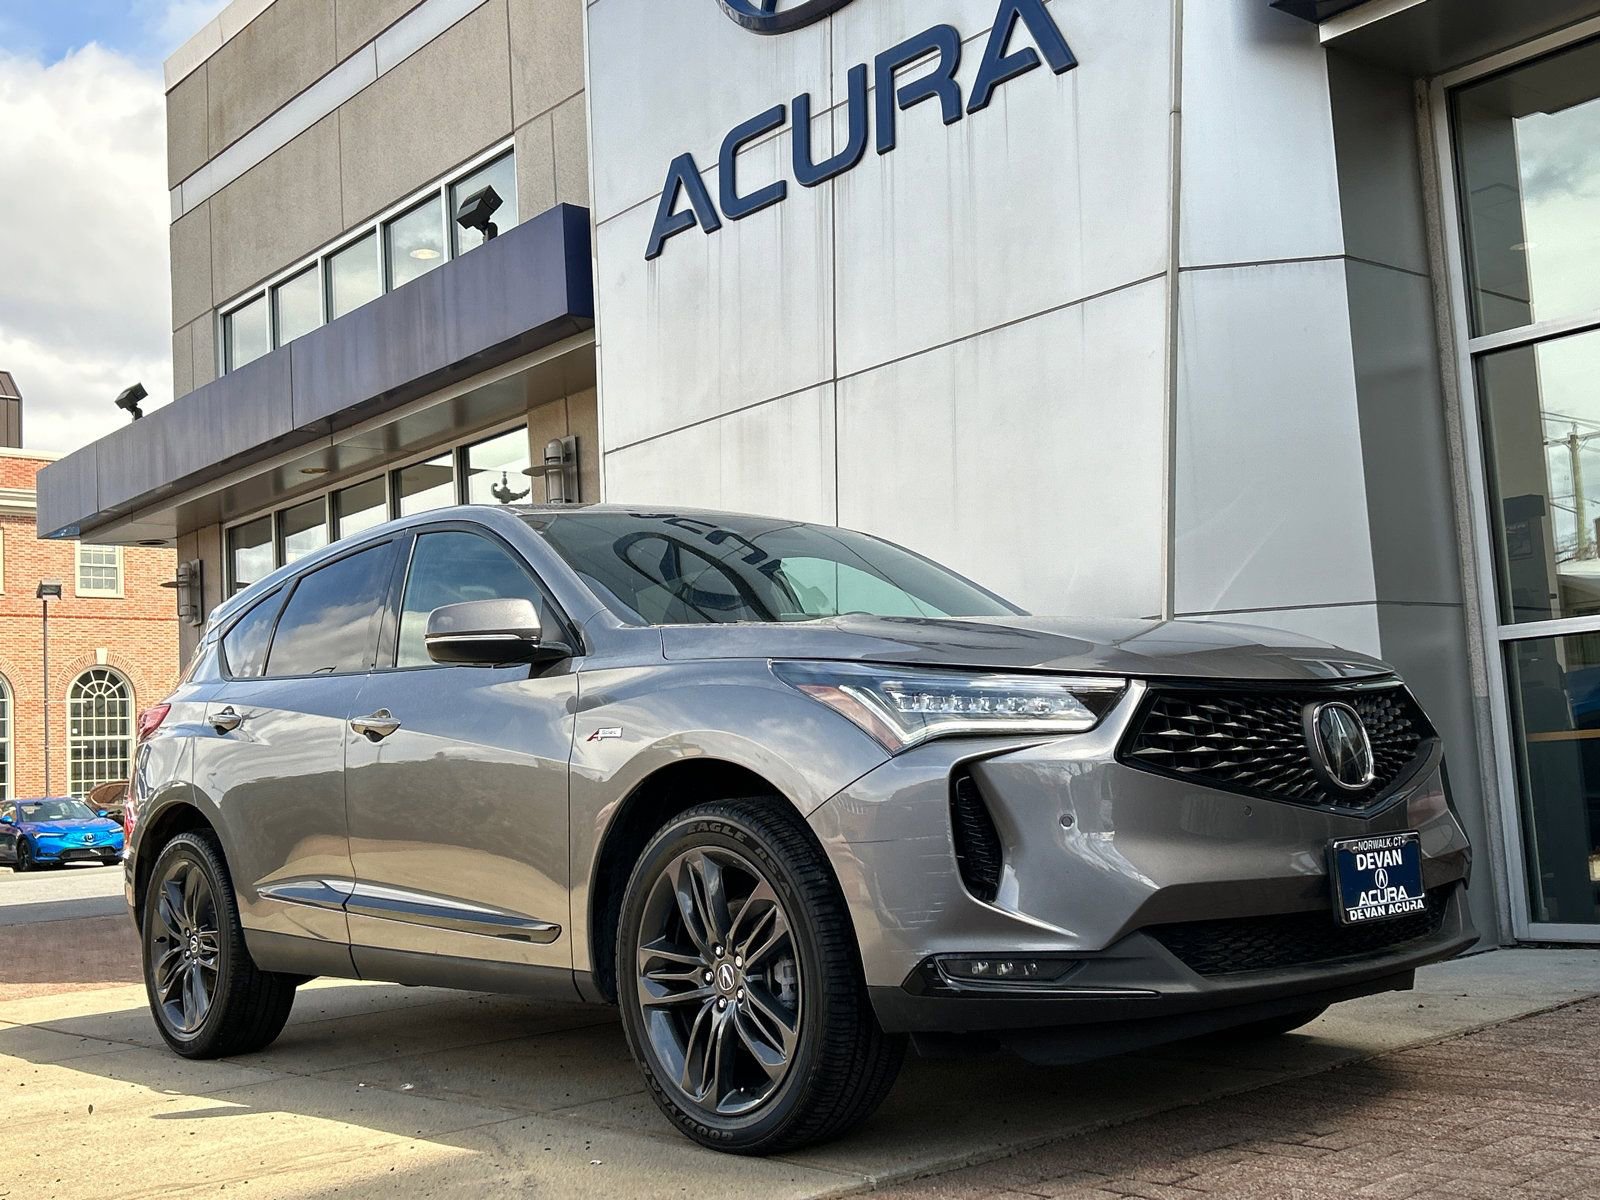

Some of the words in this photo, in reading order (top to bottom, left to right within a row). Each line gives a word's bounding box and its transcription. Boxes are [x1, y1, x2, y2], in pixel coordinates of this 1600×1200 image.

[644, 0, 1079, 261] ACURA
[687, 822, 748, 842] EAGLE
[1393, 836, 1402, 847] CT
[1356, 849, 1403, 871] DEVAN
[1358, 886, 1409, 907] ACURA
[1350, 907, 1386, 921] DEVAN
[1388, 900, 1425, 915] ACURA
